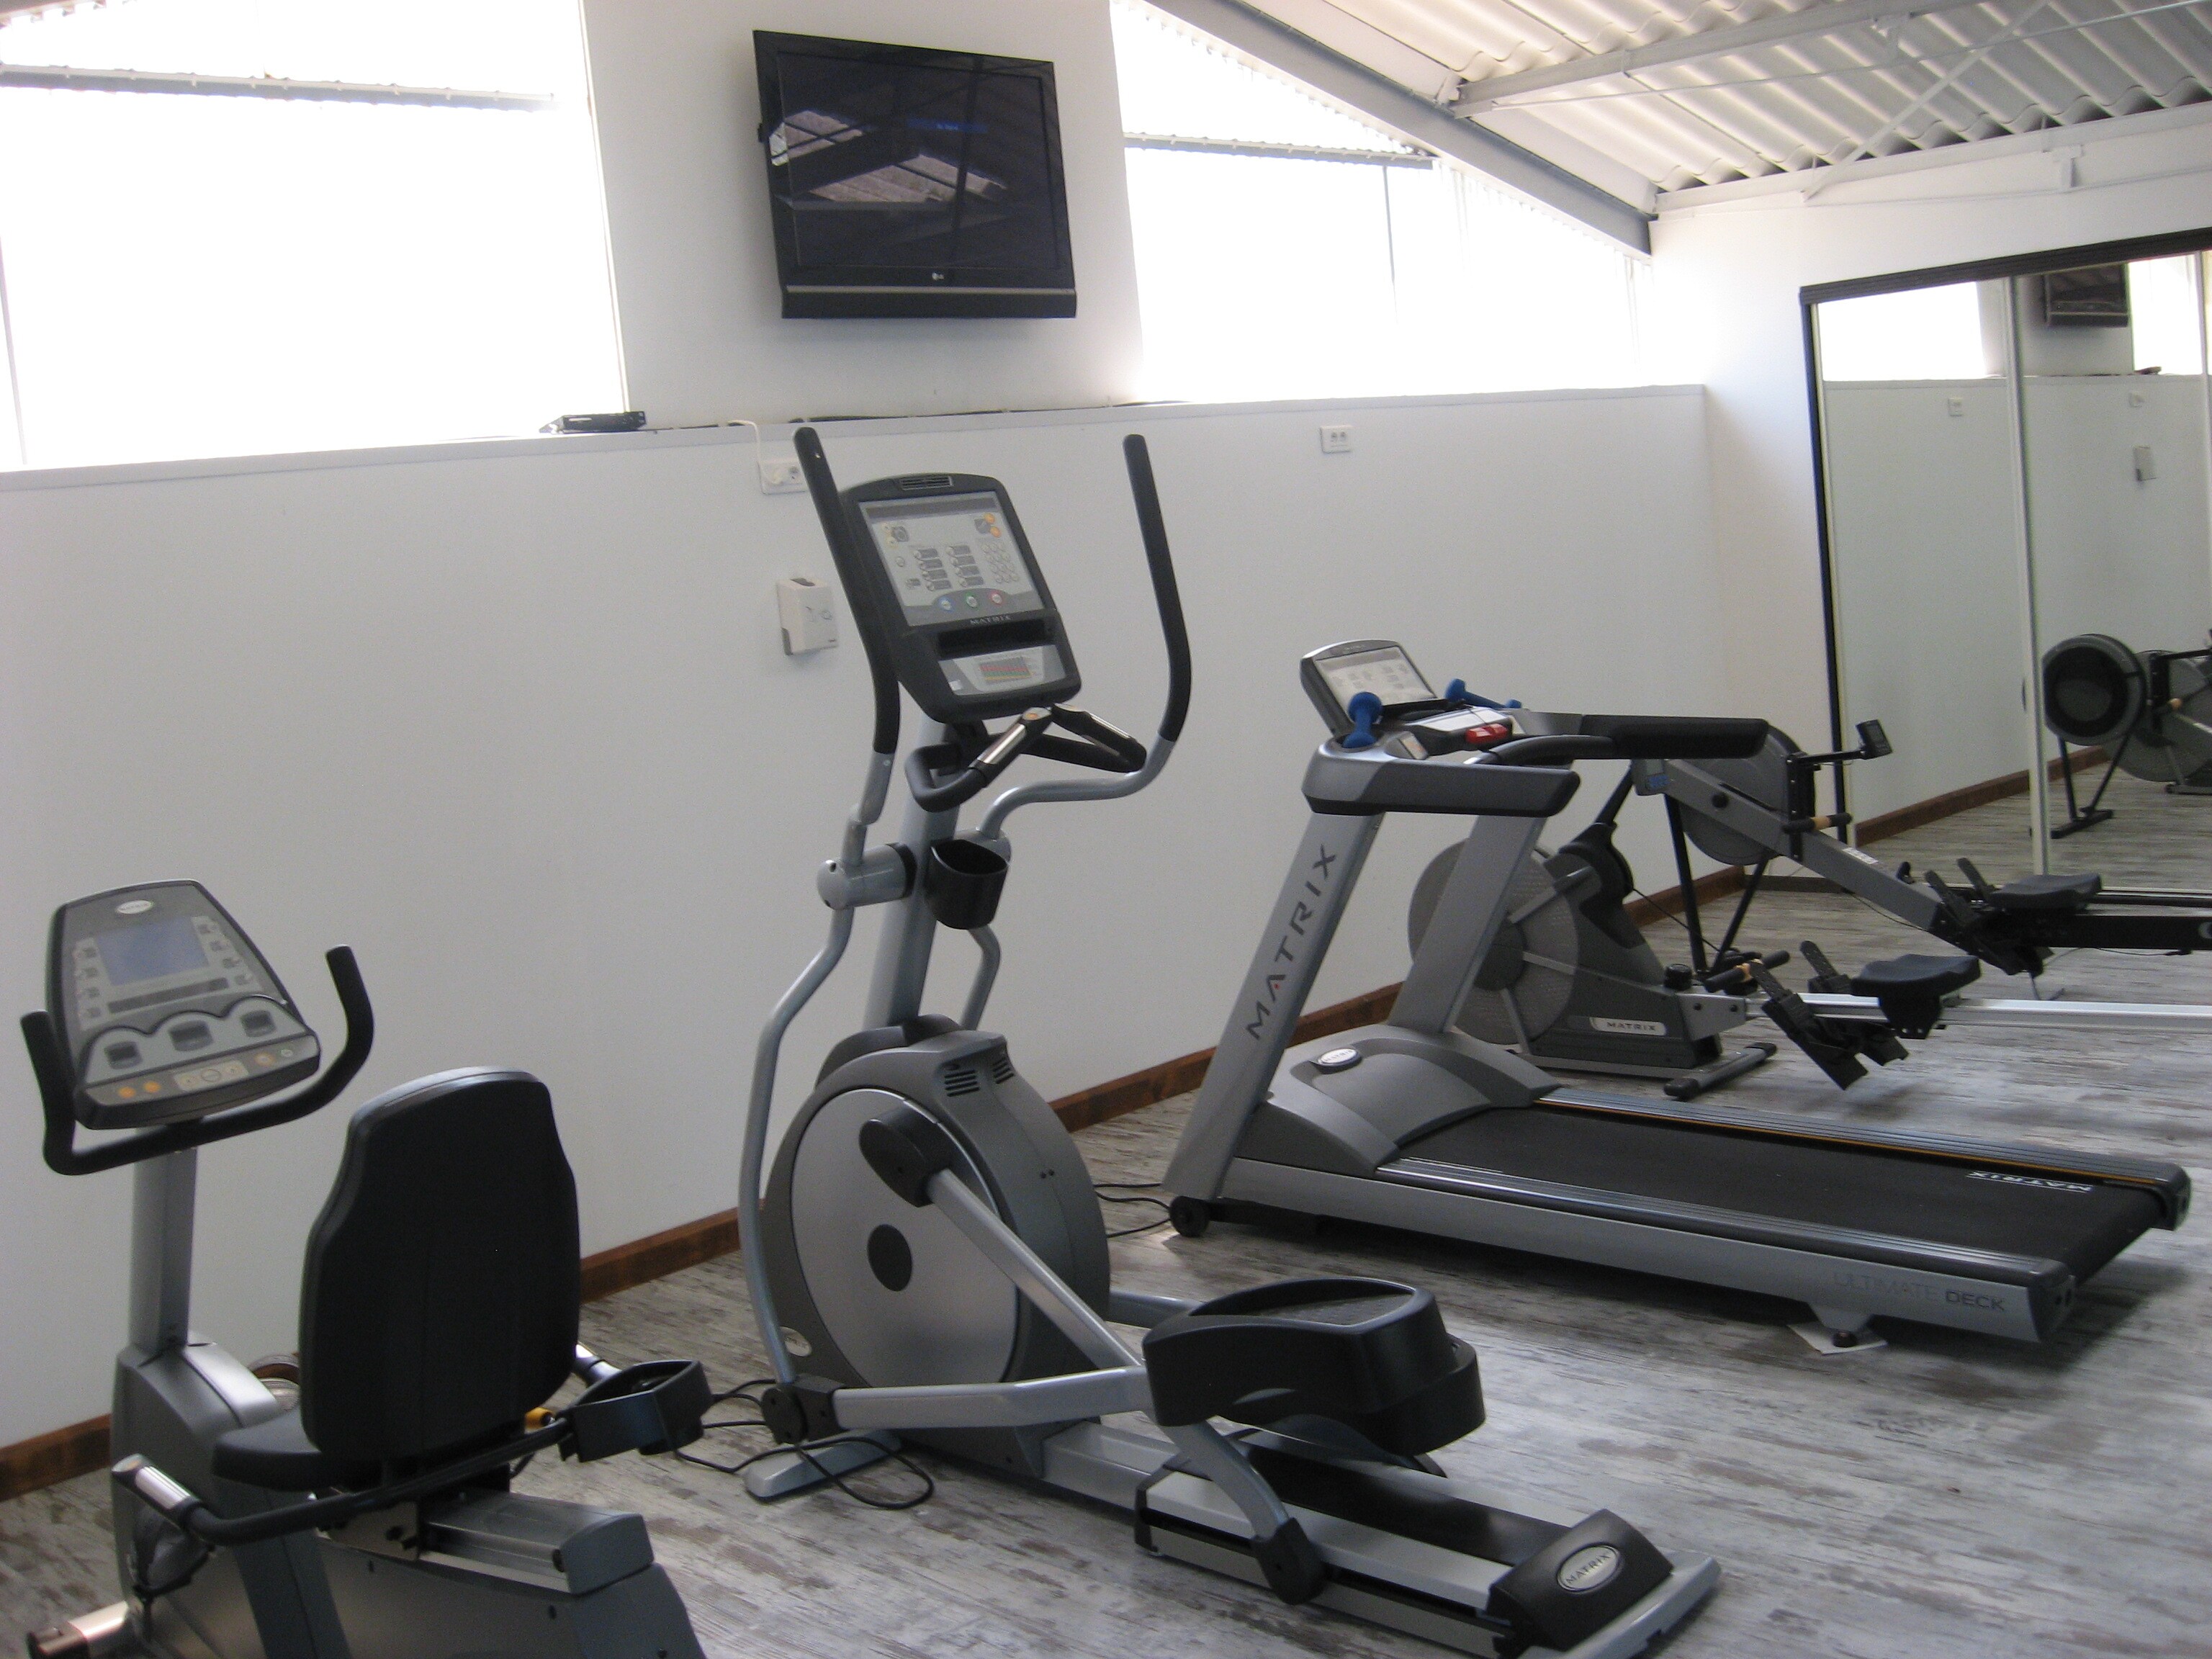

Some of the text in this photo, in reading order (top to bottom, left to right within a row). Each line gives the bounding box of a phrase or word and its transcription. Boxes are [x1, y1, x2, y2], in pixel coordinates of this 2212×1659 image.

[1246, 844, 1336, 1040] MATRIX
[1606, 1021, 1656, 1031] MATRIX
[1946, 1288, 2005, 1311] DECK
